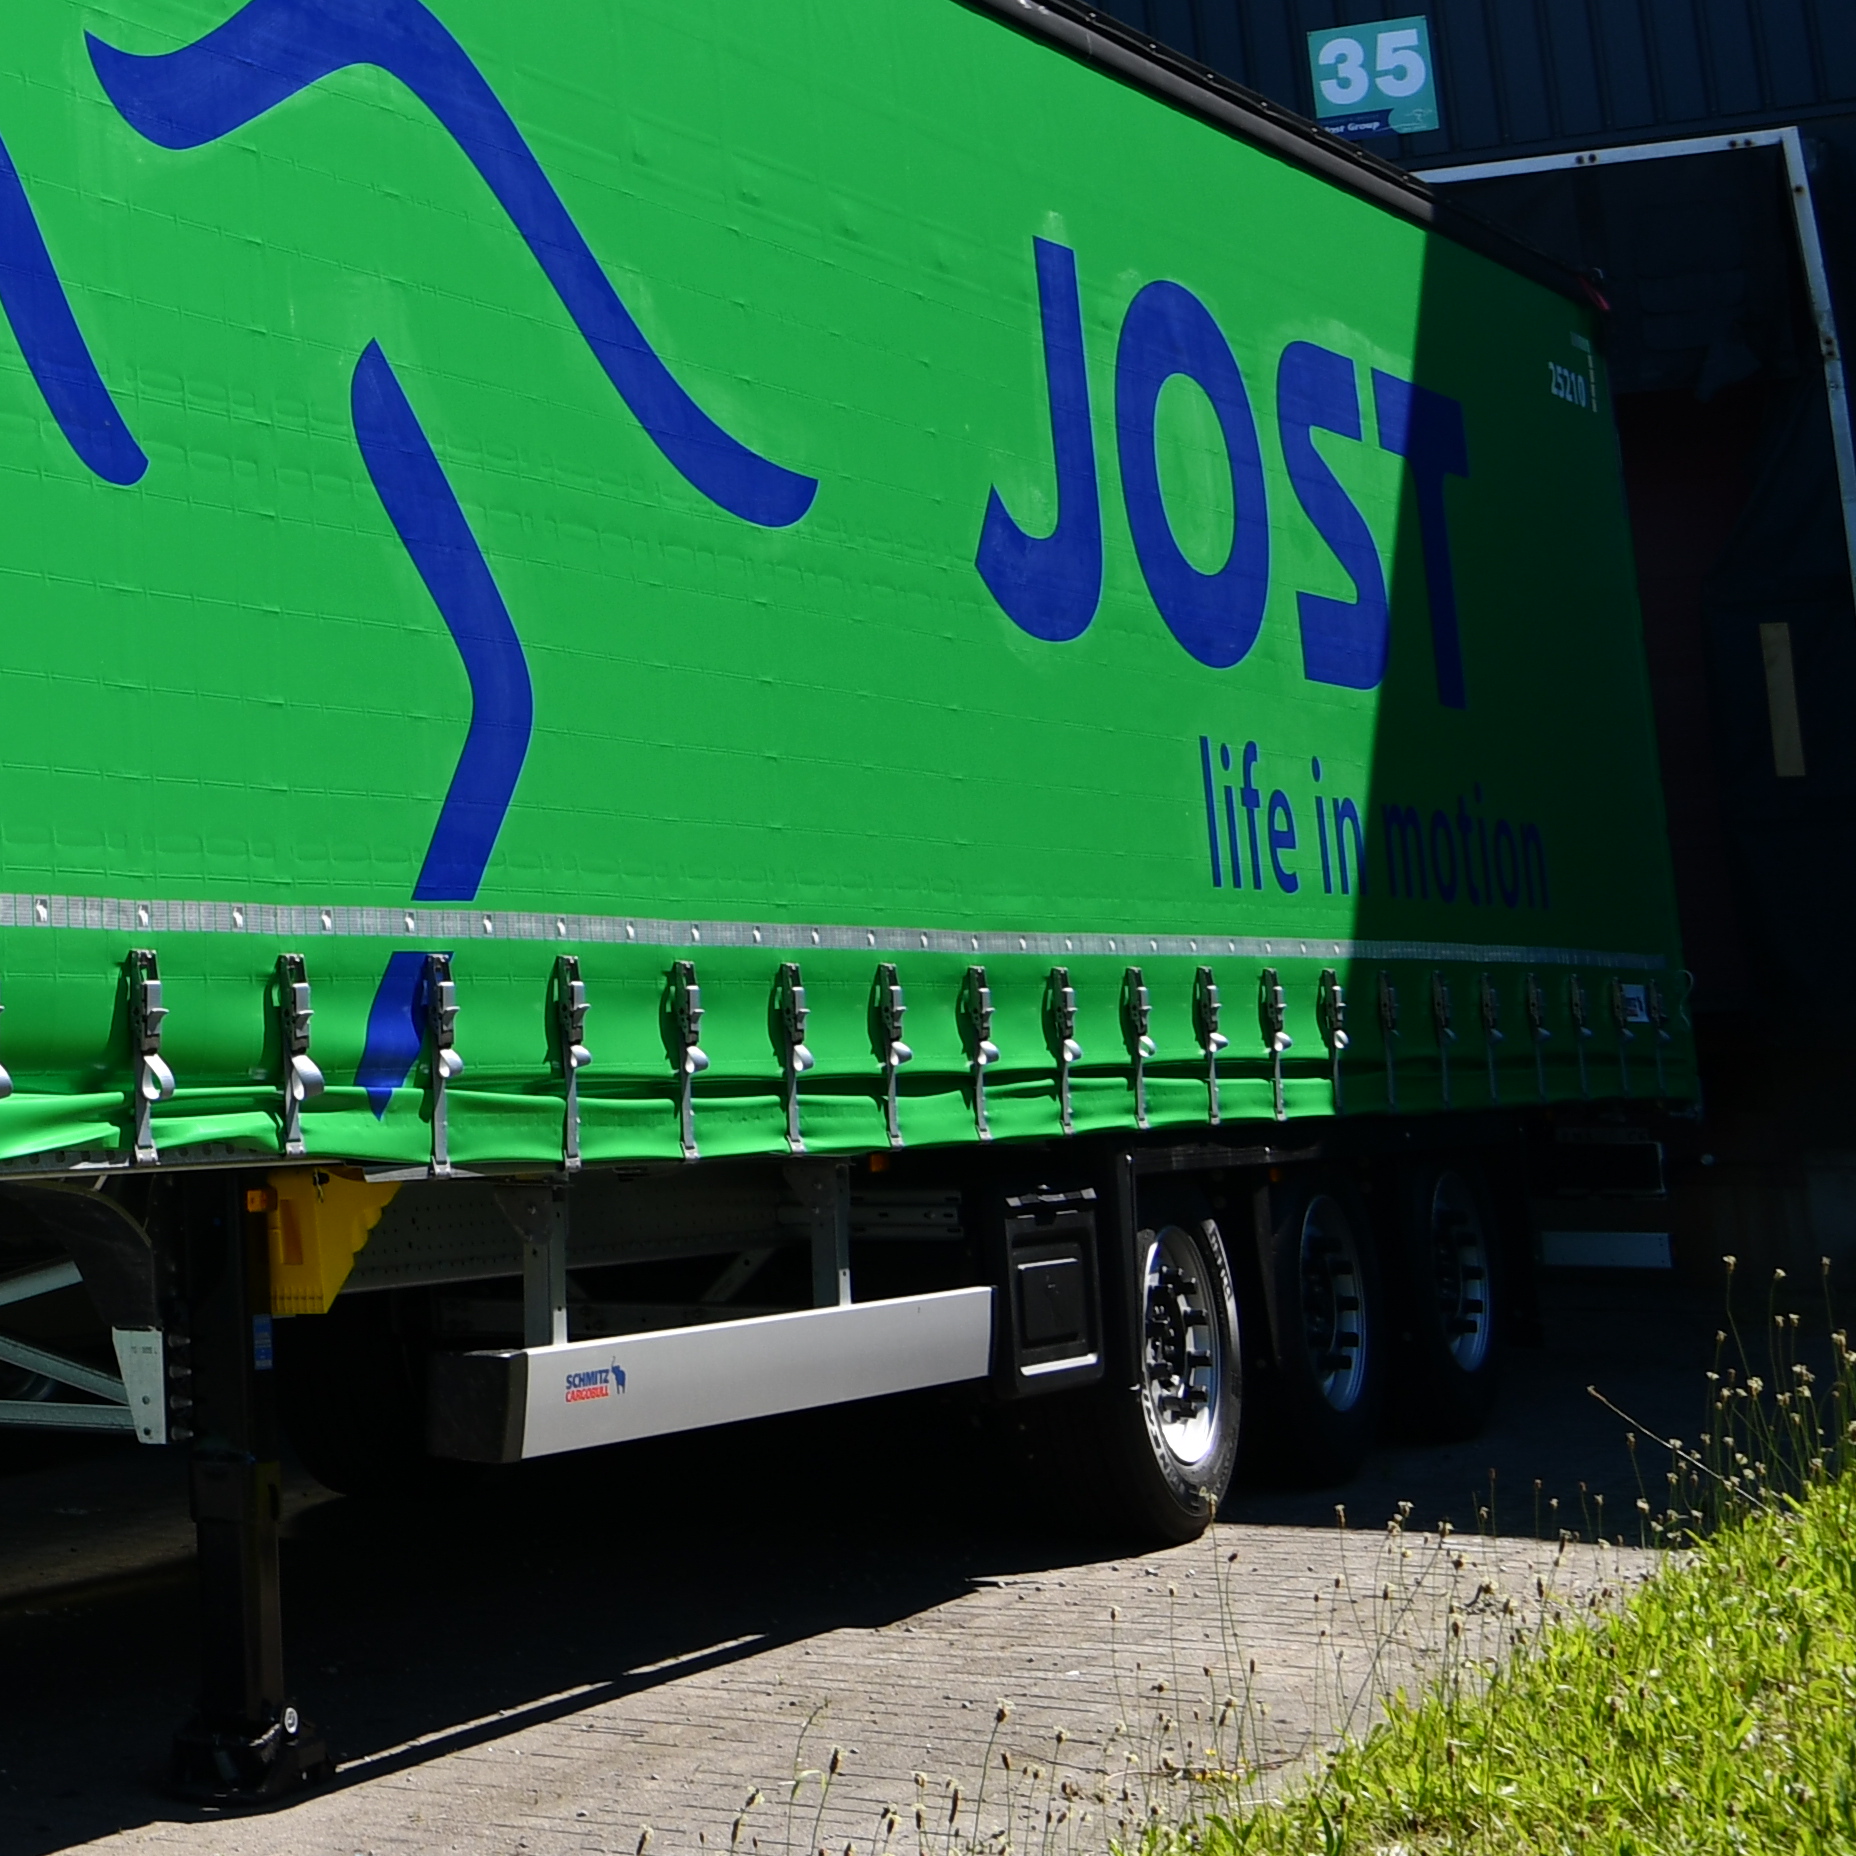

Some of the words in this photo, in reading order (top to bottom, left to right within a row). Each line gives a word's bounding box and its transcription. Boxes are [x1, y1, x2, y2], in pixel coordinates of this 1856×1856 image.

[1318, 28, 1426, 105] 35
[1347, 121, 1380, 131] Group
[1548, 360, 1586, 408] 25210
[975, 236, 1470, 710] JOST
[1199, 735, 1298, 894] life
[1311, 756, 1367, 895] in
[1381, 781, 1549, 909] motion
[566, 1368, 610, 1390] SCHMITZ
